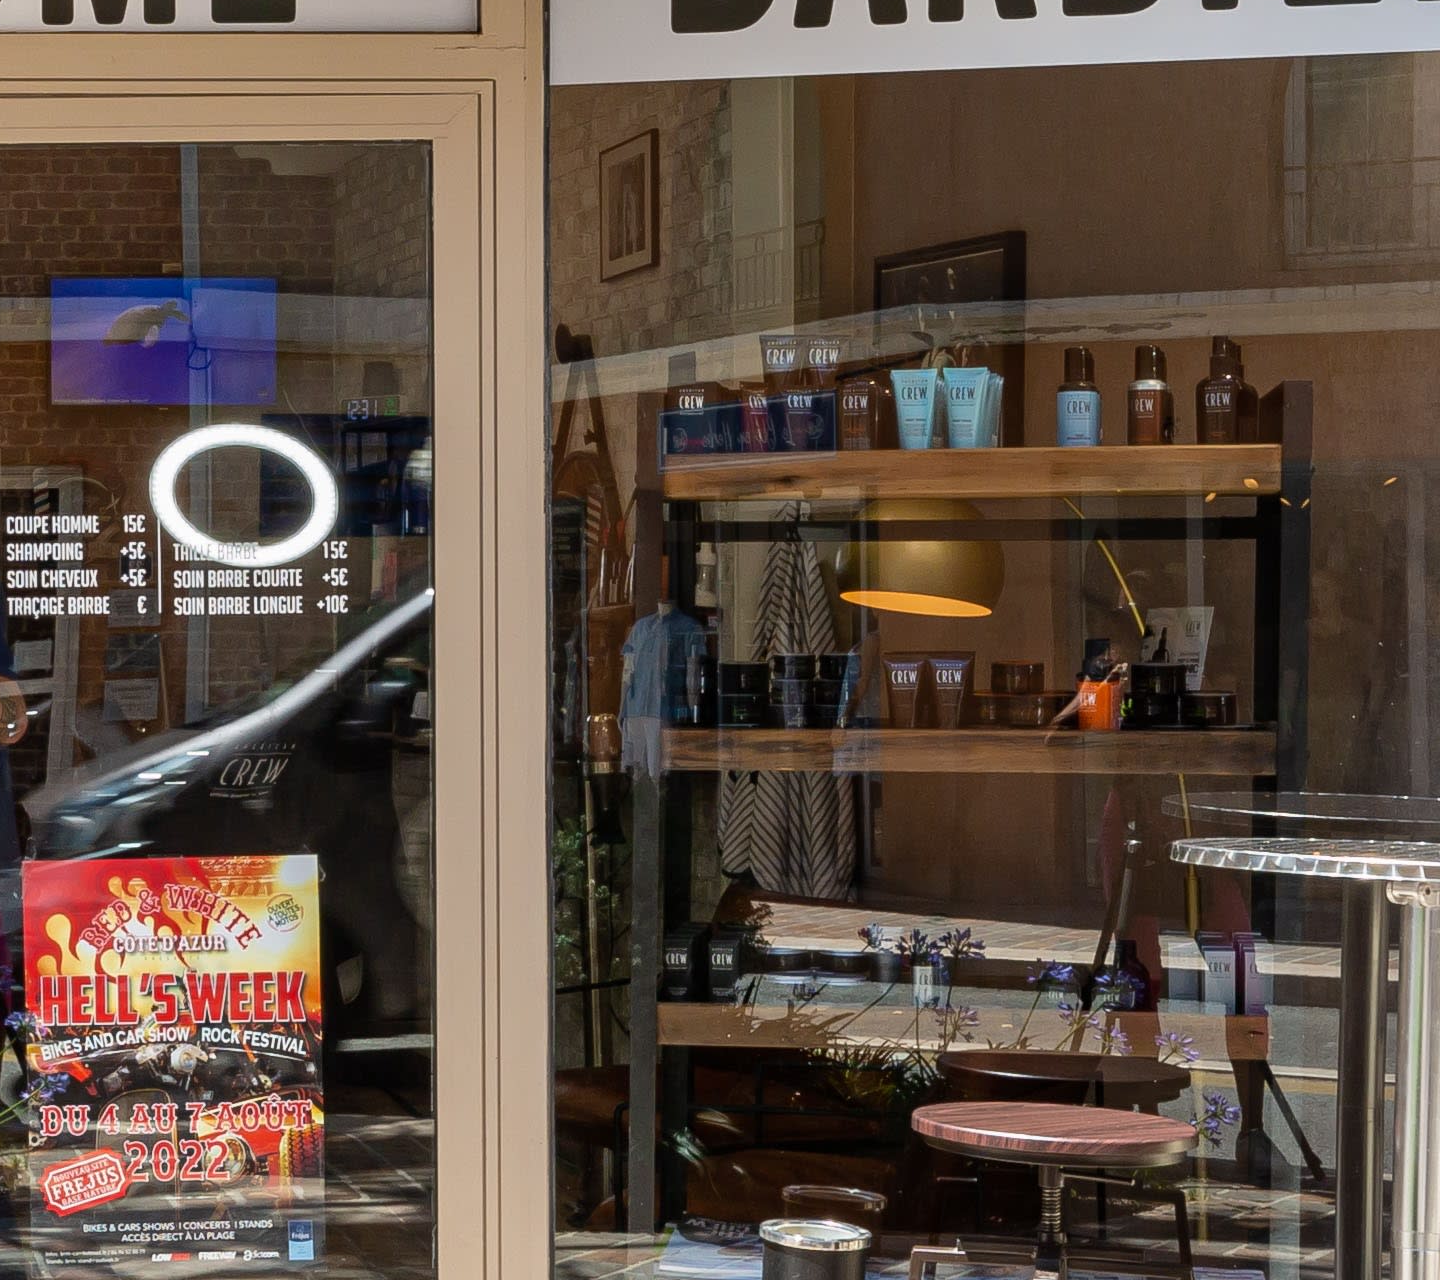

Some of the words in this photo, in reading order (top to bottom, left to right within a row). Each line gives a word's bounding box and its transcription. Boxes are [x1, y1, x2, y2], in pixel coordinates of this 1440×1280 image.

[766, 348, 796, 365] CREW
[809, 348, 839, 365] CREW
[787, 394, 812, 408] CREW
[901, 386, 928, 401] CREW
[950, 386, 976, 400] CREW
[1205, 392, 1231, 407] CREW
[679, 395, 704, 410] CREW
[843, 396, 868, 410] CREW
[1067, 399, 1091, 413] CREW
[1134, 398, 1154, 412] REW
[6, 515, 49, 535] COUPE
[51, 515, 100, 534] HOMME
[122, 514, 146, 533] 15€
[6, 542, 84, 562] SHAMPOING
[120, 541, 147, 561] +5€
[172, 543, 212, 561] TAILLE
[217, 541, 259, 560] BARBE
[322, 541, 348, 560] 15€
[6, 569, 38, 589] SOIN
[41, 569, 99, 588] CHEVEUX
[120, 568, 147, 588] +5€
[173, 569, 205, 589] SOIN
[207, 569, 250, 588] BARBE
[252, 568, 303, 588] COURTE
[321, 567, 349, 587] +5€
[7, 596, 65, 620] TRAÇAGE
[68, 596, 111, 616] BARBE
[136, 596, 147, 614] €
[173, 597, 205, 616] SOIN
[207, 596, 251, 616] BARBE
[253, 596, 303, 615] LONGUE
[316, 595, 349, 614] +10€
[891, 670, 918, 685] CREW
[936, 669, 963, 684] CREW
[79, 899, 133, 954] RED
[138, 887, 161, 915] &
[164, 883, 264, 952] WHITE
[162, 933, 227, 952] D'AZUR
[665, 952, 688, 965] CREW
[711, 952, 734, 965] CREW
[41, 972, 180, 1025] HELL'S
[187, 971, 307, 1024] WEEK
[40, 1038, 82, 1061] BIKES
[83, 1032, 114, 1051] AND
[115, 1028, 145, 1046] CAR
[149, 1026, 191, 1044] SHOW
[201, 1026, 241, 1045] ROCK
[242, 1031, 307, 1056] FESTIVAL
[40, 1103, 91, 1136] DU
[97, 1103, 120, 1136] 4
[127, 1102, 177, 1135] AU
[185, 1101, 205, 1134] 7
[214, 1093, 313, 1133] AOÛT
[123, 1138, 231, 1183] 2022
[51, 1166, 119, 1201] FREJUS
[83, 1223, 107, 1233] BIKES
[118, 1222, 142, 1232] CARS
[142, 1221, 175, 1231] SHOWS
[183, 1220, 231, 1231] CONCERTS
[238, 1219, 273, 1230] STANDS
[121, 1231, 151, 1243] ACCÈS
[152, 1231, 184, 1242] DIRECT
[193, 1231, 205, 1241] LA
[206, 1230, 236, 1241] PLAGE
